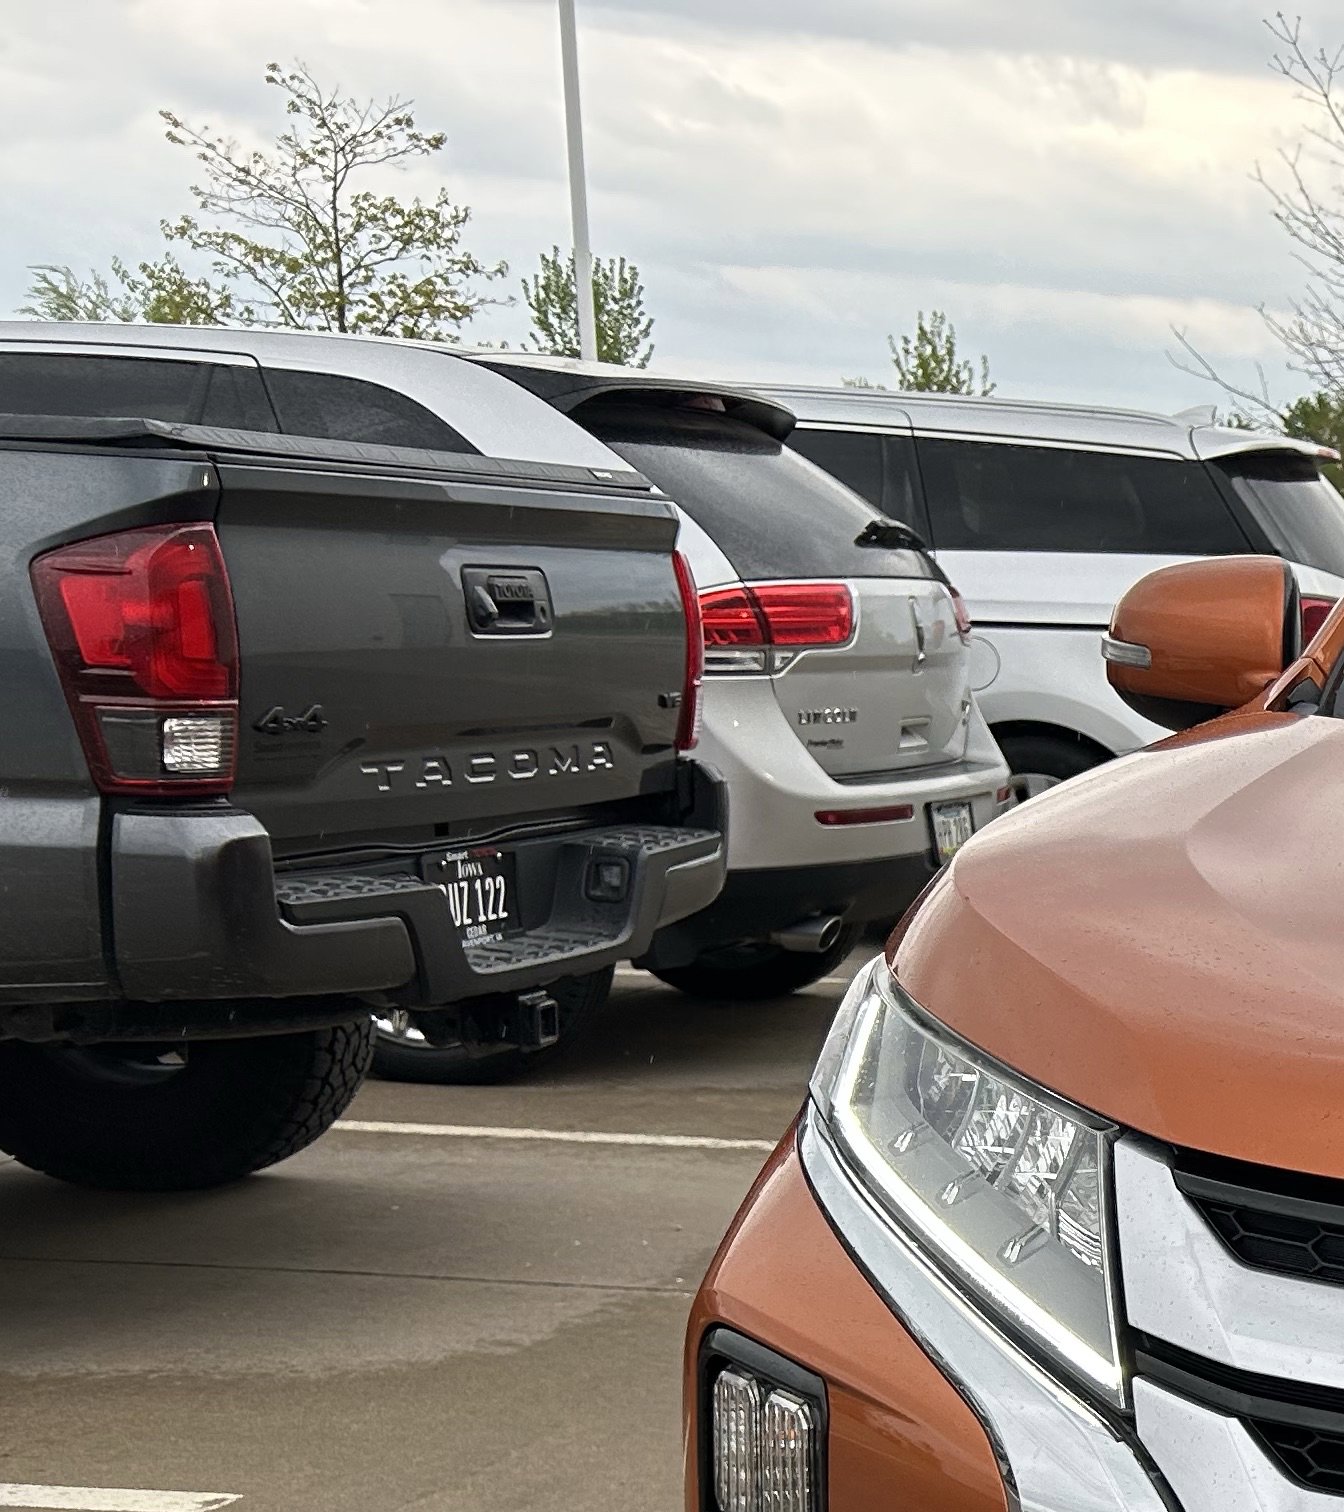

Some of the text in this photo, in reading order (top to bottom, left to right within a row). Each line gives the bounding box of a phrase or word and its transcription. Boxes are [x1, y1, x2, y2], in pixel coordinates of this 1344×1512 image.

[360, 742, 614, 791] TACOMA
[439, 875, 508, 927] UZ 122
